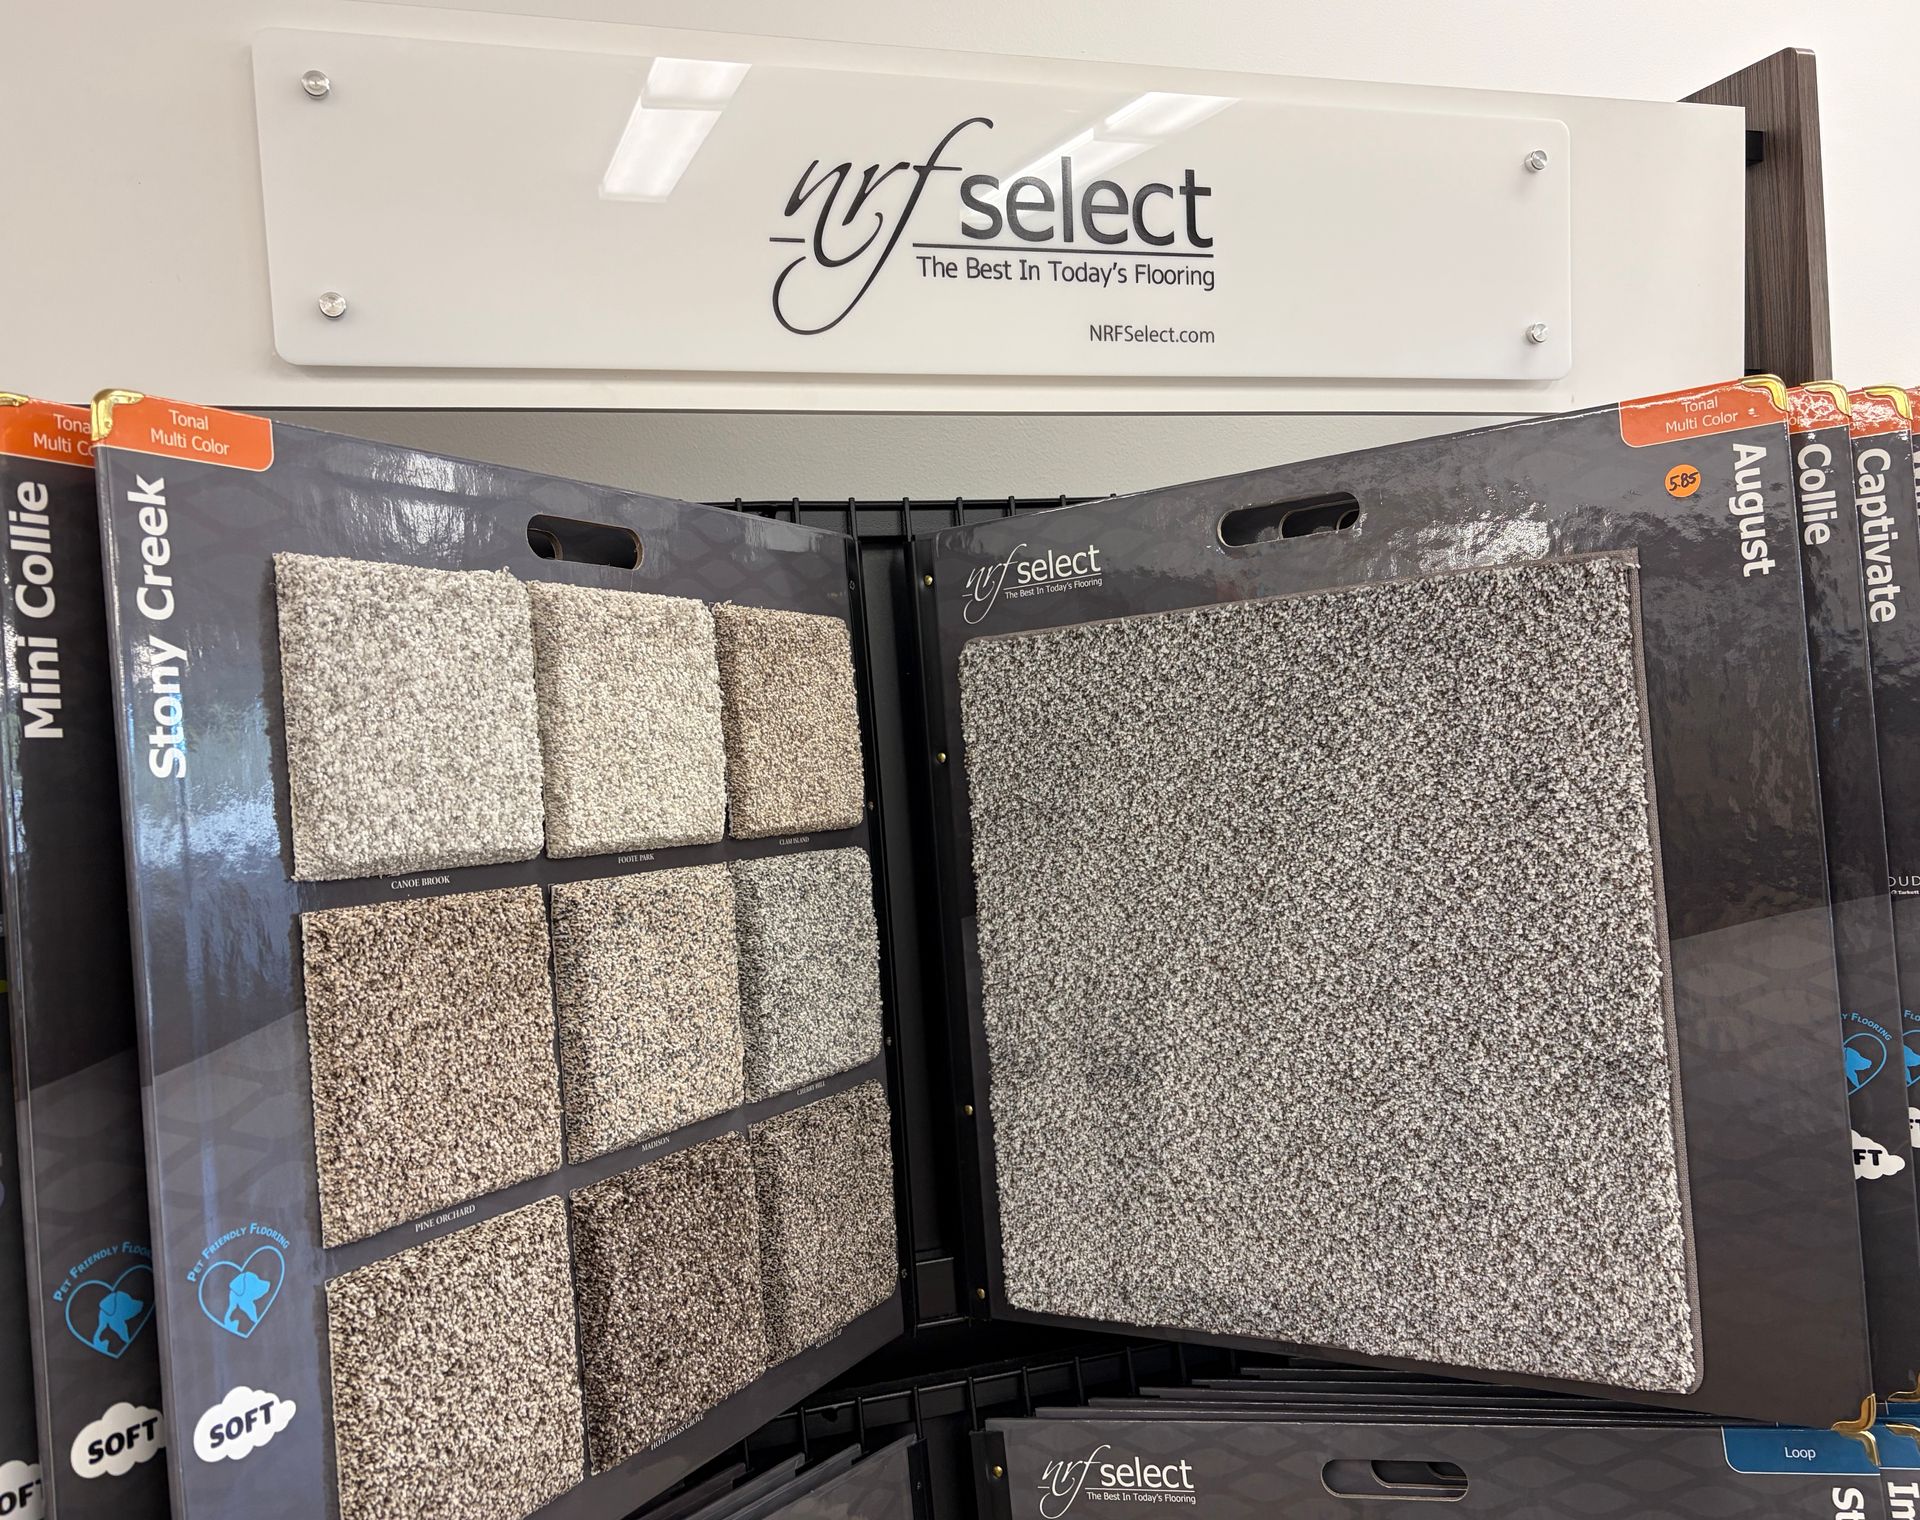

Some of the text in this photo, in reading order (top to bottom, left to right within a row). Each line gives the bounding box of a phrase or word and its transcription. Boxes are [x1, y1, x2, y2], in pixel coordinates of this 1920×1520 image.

[960, 156, 1214, 248] select
[916, 256, 1216, 291] The Best In Today's Flooring
[1089, 324, 1215, 343] NRFSelect.com
[1681, 396, 1718, 413] Tonal
[53, 413, 92, 434] Tona
[168, 409, 209, 430] Tonal
[1665, 412, 1738, 433] Multi Color
[33, 431, 72, 453] Multi
[151, 427, 230, 455] Multi Color
[1797, 443, 1838, 546] Collie
[1728, 443, 1776, 578] August
[1855, 448, 1901, 623] Captivate
[1017, 544, 1101, 584] select
[1005, 577, 1102, 599] The Best In Today's Flooring
[9, 480, 64, 739] Mini Collie
[126, 474, 188, 779] Stony Creek
[618, 853, 654, 864] FOOTE PARK
[391, 875, 450, 889] CANOE BROOK
[642, 1136, 670, 1152] MADISON
[1853, 1149, 1883, 1166] FT
[415, 1204, 476, 1233] PINE ORCHARD
[209, 1401, 275, 1449] SOFT
[87, 1417, 159, 1465] SOFT
[1785, 1447, 1816, 1461] Loop
[1100, 1456, 1195, 1489] select
[1086, 1492, 1197, 1505] The Best In Today's Flooring
